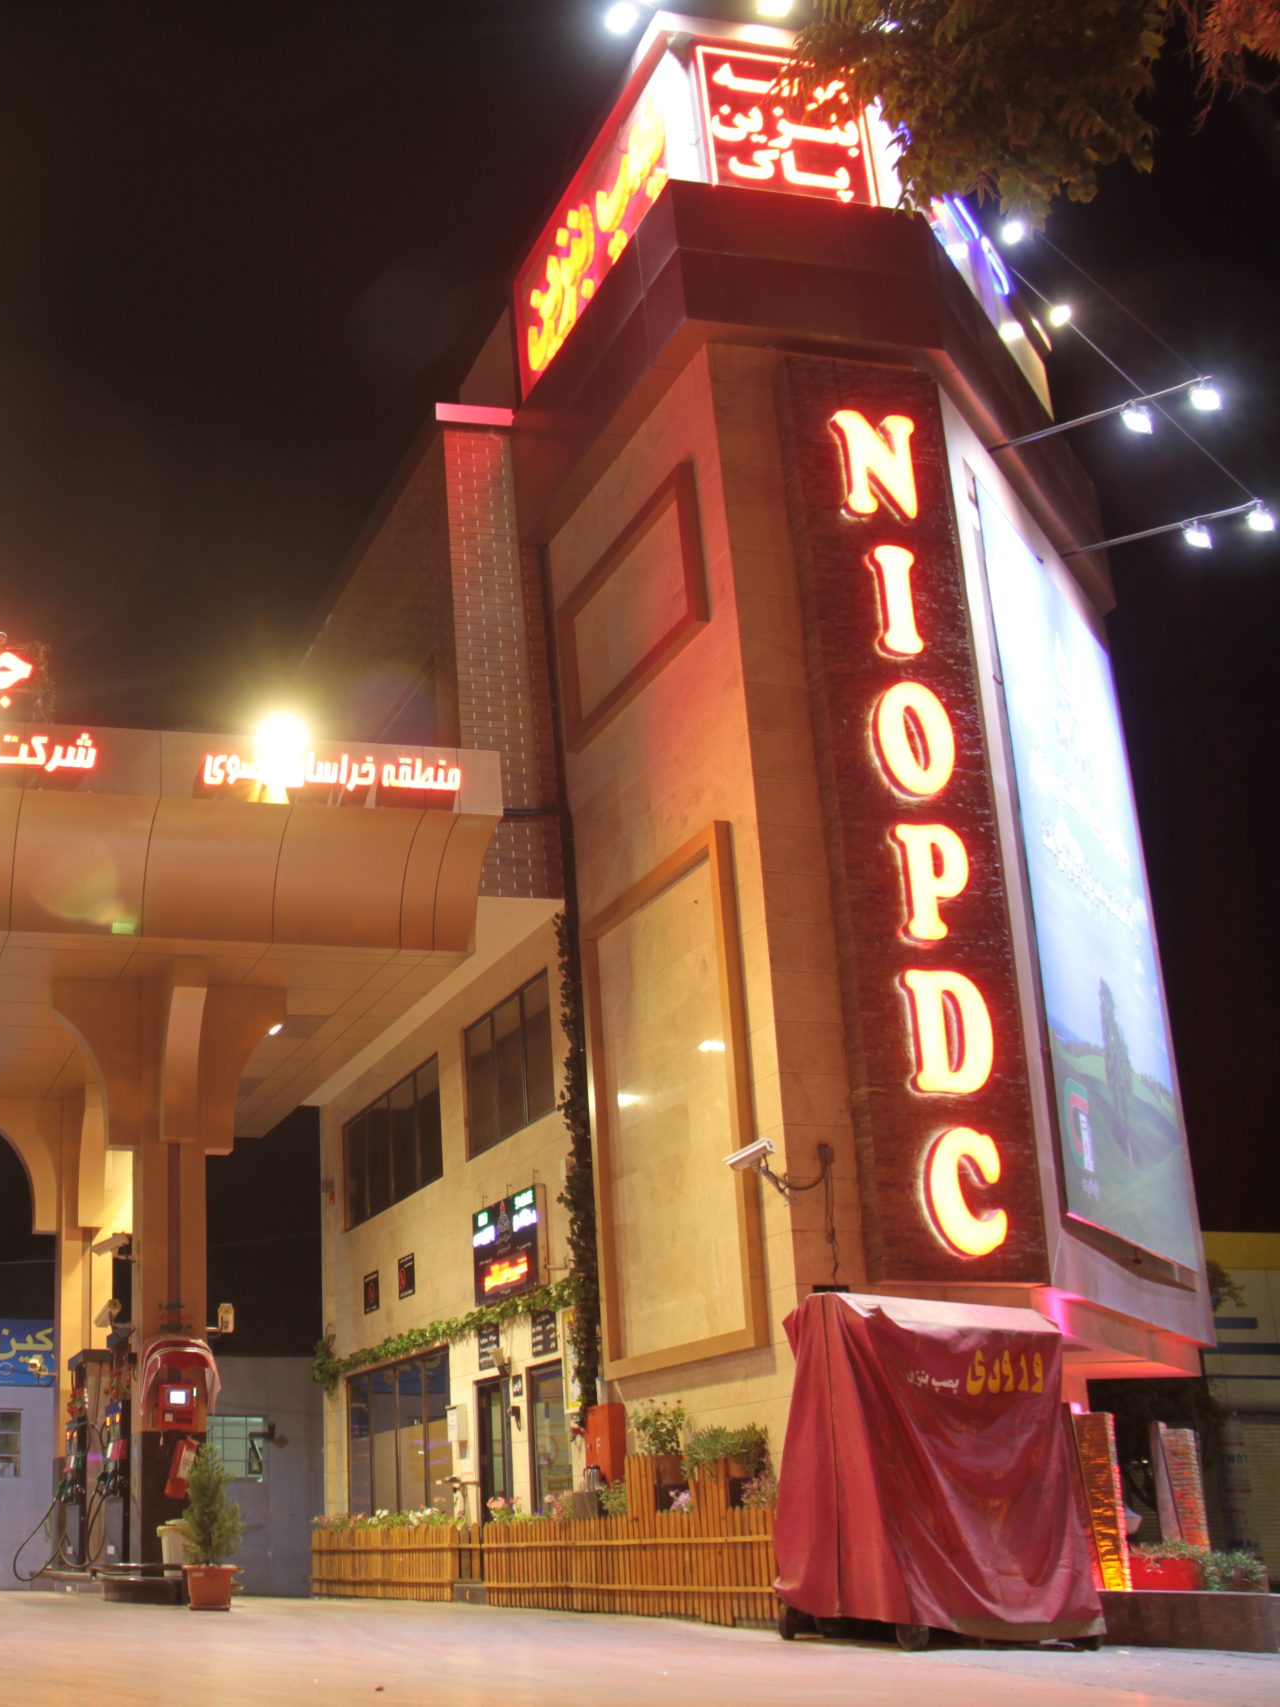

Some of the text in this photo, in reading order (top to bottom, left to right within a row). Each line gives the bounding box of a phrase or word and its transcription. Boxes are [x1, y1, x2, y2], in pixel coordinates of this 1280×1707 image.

[711, 104, 860, 158] بنزین
[728, 148, 855, 203] پاک
[382, 756, 462, 792] منطقه
[830, 408, 1008, 1260] NIOPDC
[966, 1349, 1044, 1396] ورودی
